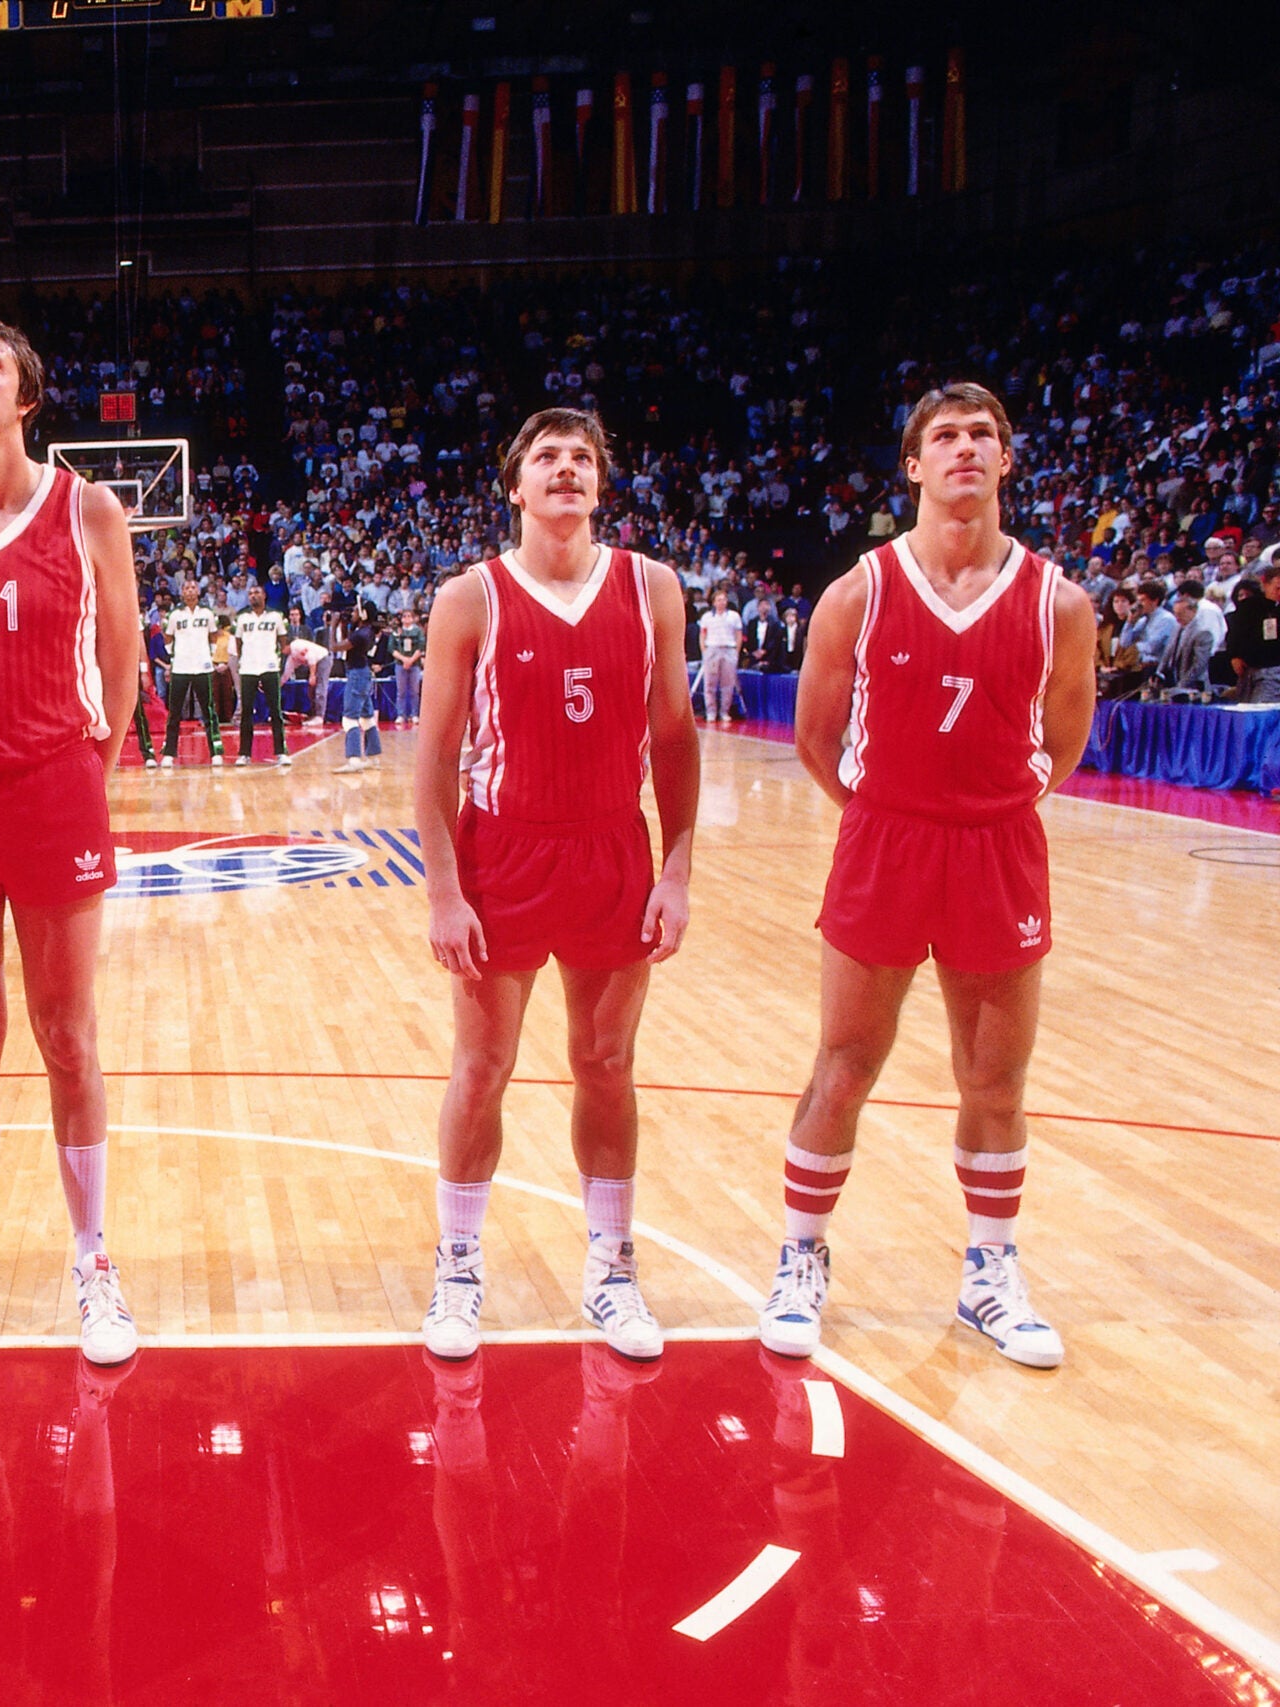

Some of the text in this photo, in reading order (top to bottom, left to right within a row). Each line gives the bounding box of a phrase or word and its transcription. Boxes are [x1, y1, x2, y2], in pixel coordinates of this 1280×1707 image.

[563, 667, 594, 723] 5
[938, 675, 974, 733] 7
[75, 870, 104, 882] adidas
